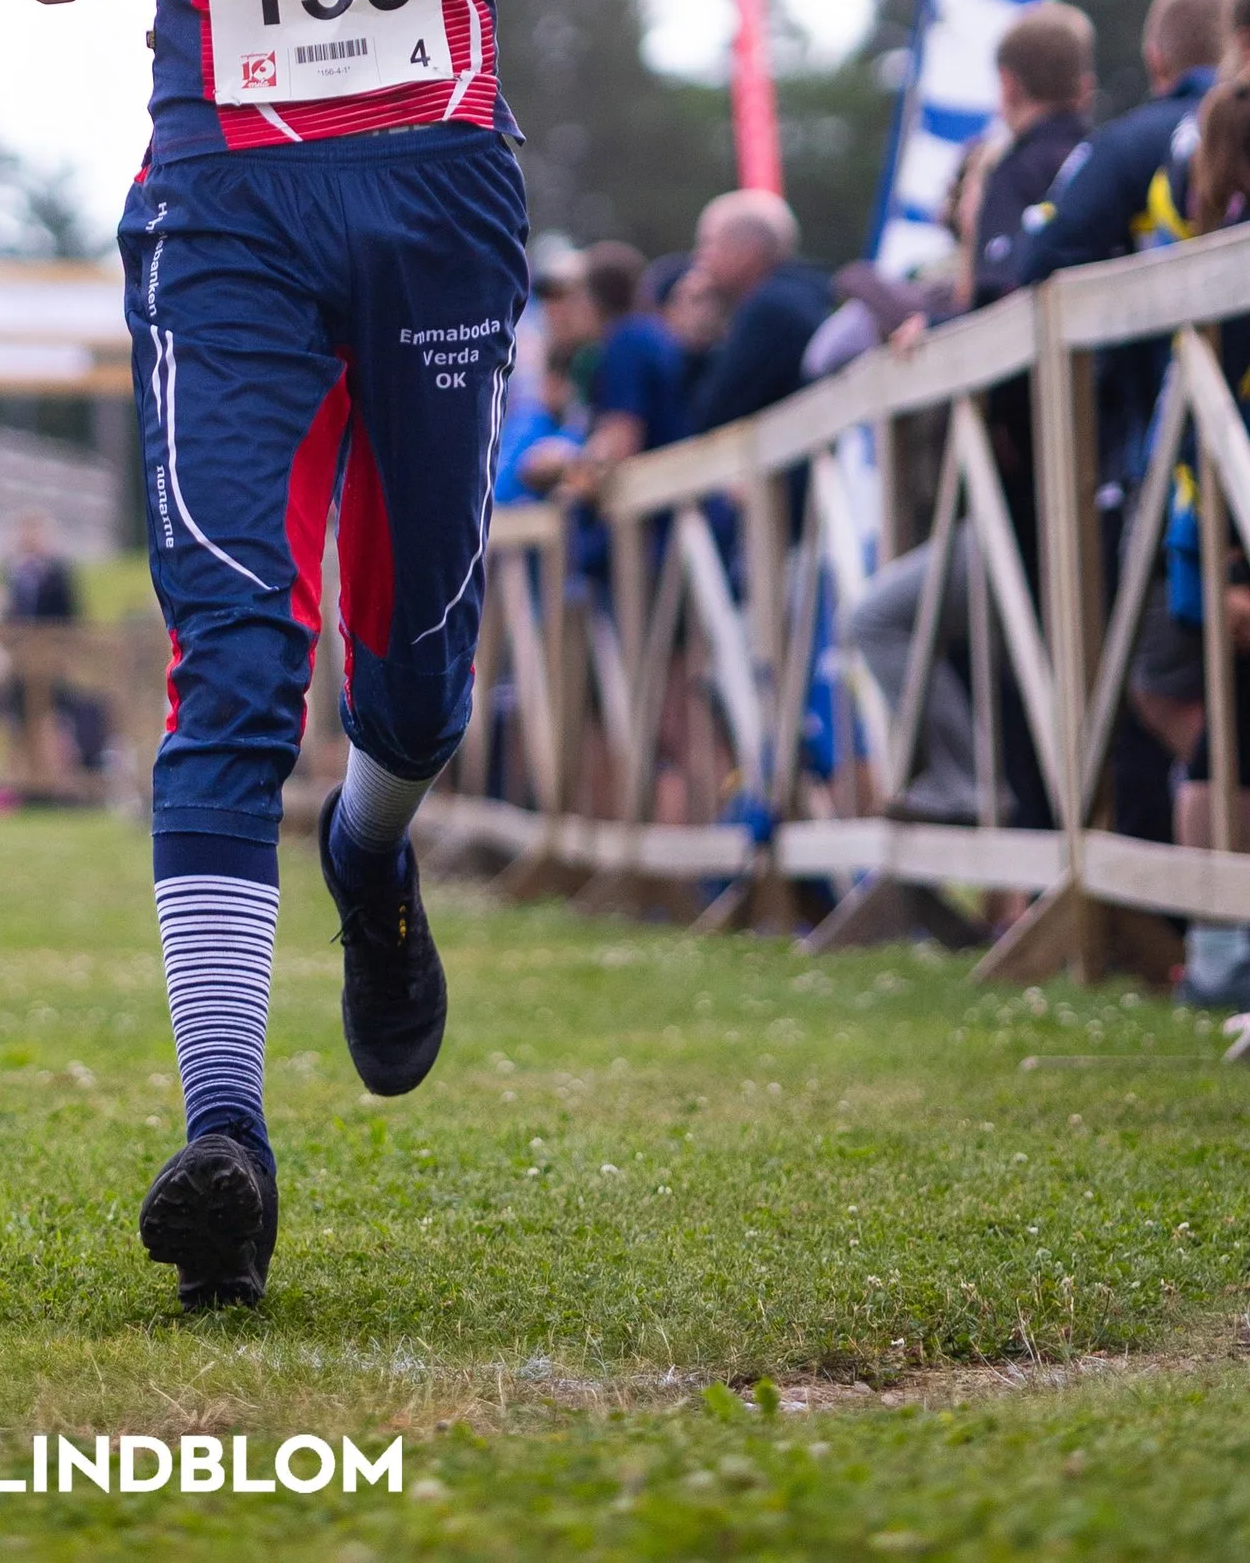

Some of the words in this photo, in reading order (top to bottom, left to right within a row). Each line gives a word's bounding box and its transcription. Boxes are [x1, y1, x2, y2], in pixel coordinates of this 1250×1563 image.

[410, 38, 431, 68] 4
[400, 318, 500, 345] Emmaboda
[423, 347, 479, 367] Verda
[435, 371, 467, 389] OK
[156, 464, 174, 548] noname
